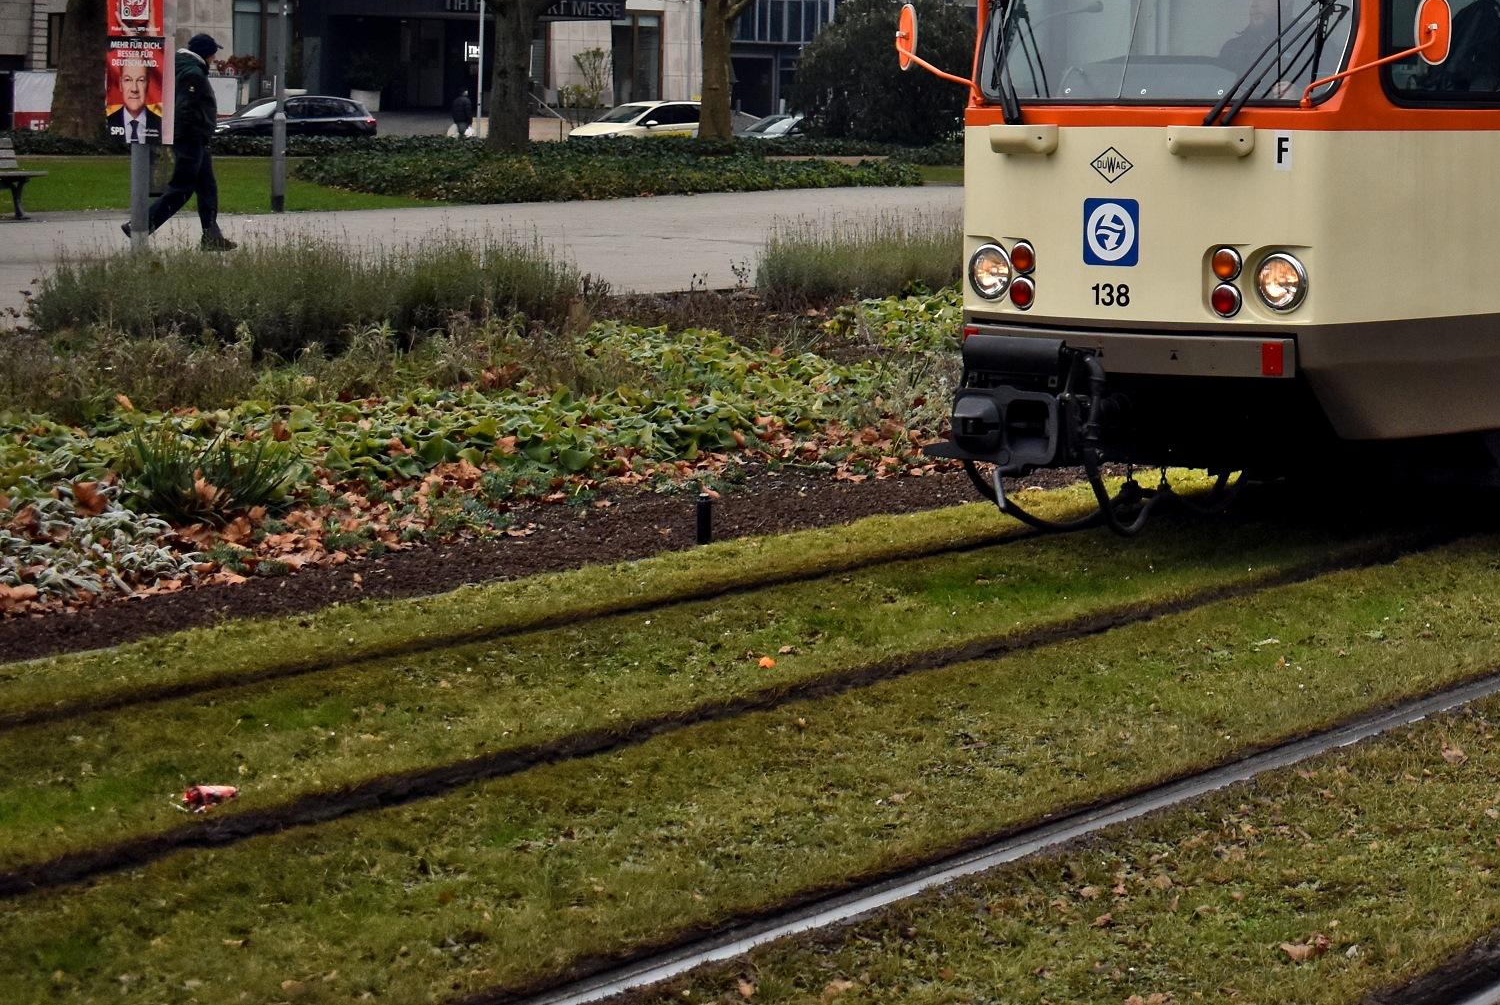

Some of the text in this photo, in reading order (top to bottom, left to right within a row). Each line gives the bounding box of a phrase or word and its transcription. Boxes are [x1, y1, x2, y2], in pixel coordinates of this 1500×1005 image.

[572, 2, 622, 18] MESSE
[110, 39, 162, 50] MEHR FÜR DICH.
[117, 49, 154, 58] BESSER FÜR
[111, 58, 159, 68] DEUTSCHLAND.
[110, 126, 125, 136] SPD
[1276, 136, 1290, 164] F
[1096, 156, 1127, 174] DUWAG
[1091, 282, 1130, 307] 138
